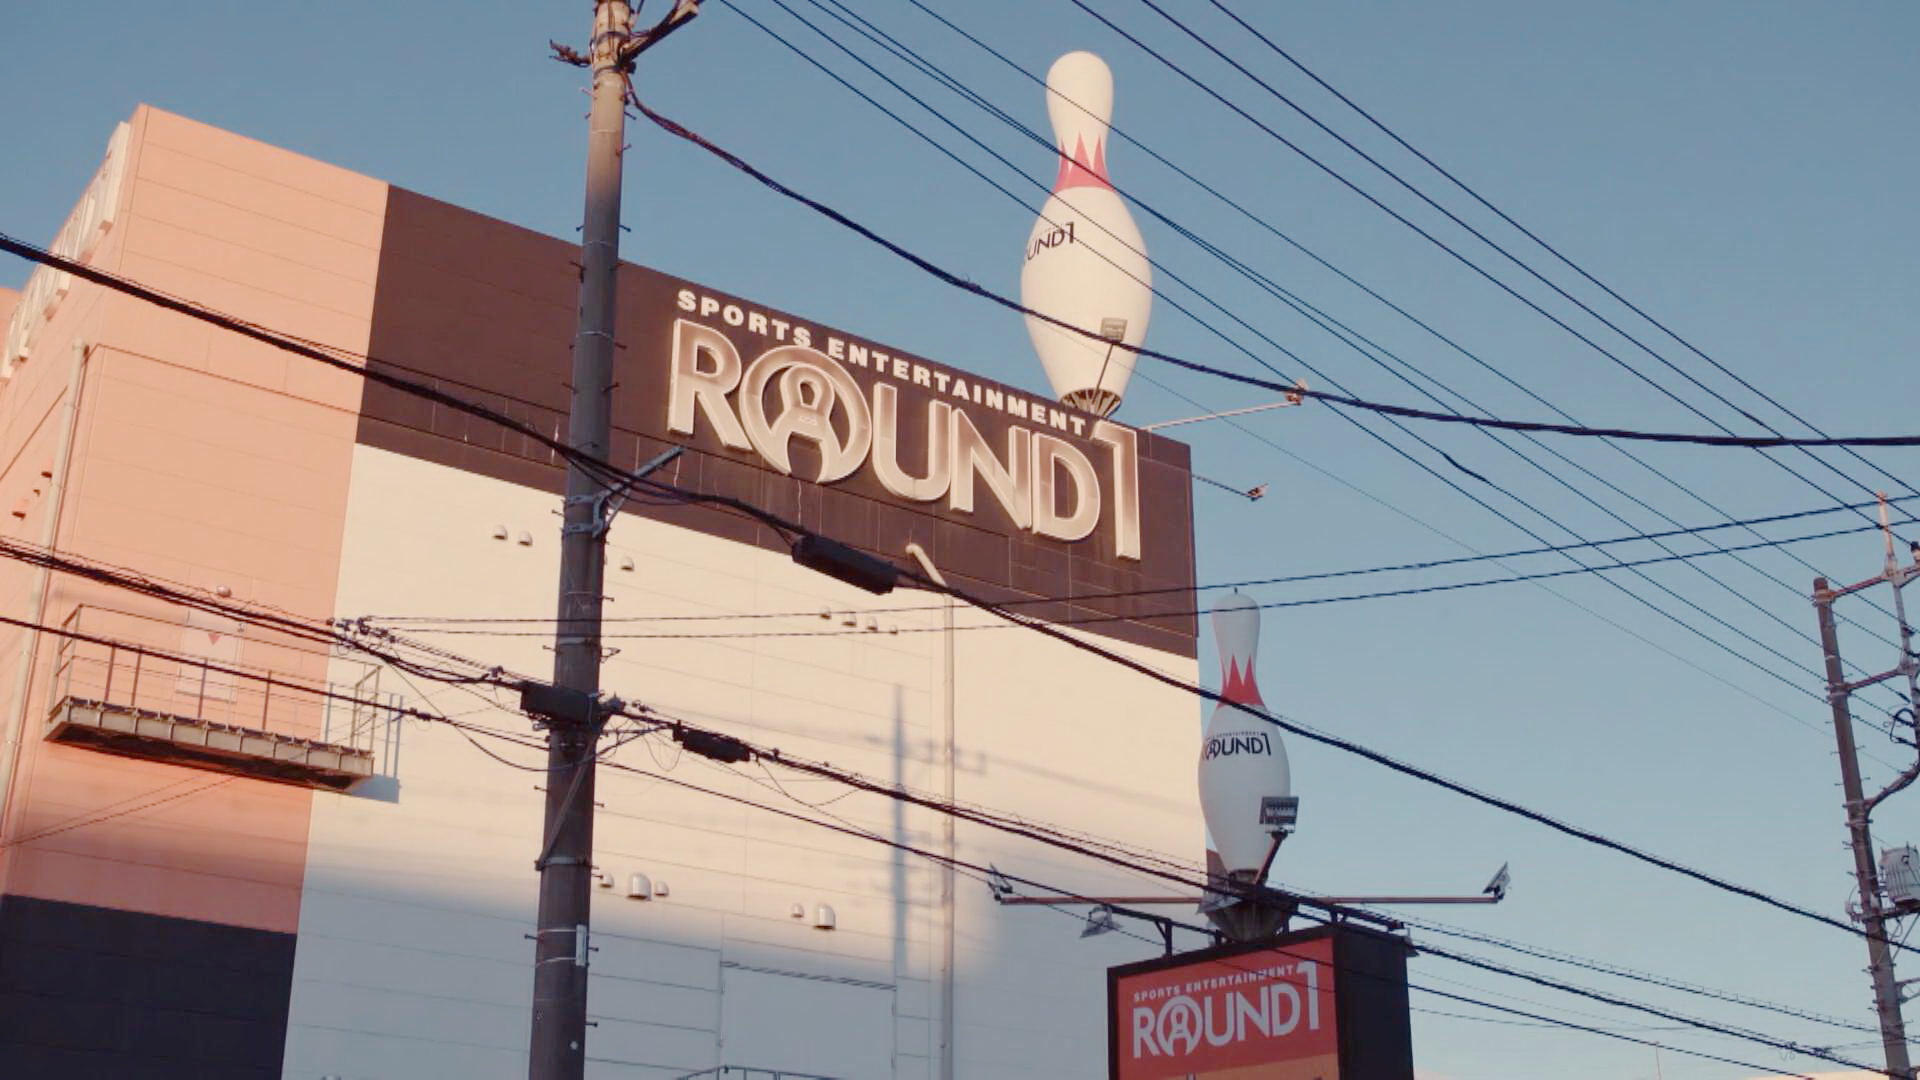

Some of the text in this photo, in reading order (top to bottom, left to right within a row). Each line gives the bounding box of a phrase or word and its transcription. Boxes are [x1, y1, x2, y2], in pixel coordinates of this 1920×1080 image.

[676, 289, 1087, 437] SPORTS ENTERTAINMENT
[1133, 964, 1294, 1003] SPORTS ENTERTAINMENT
